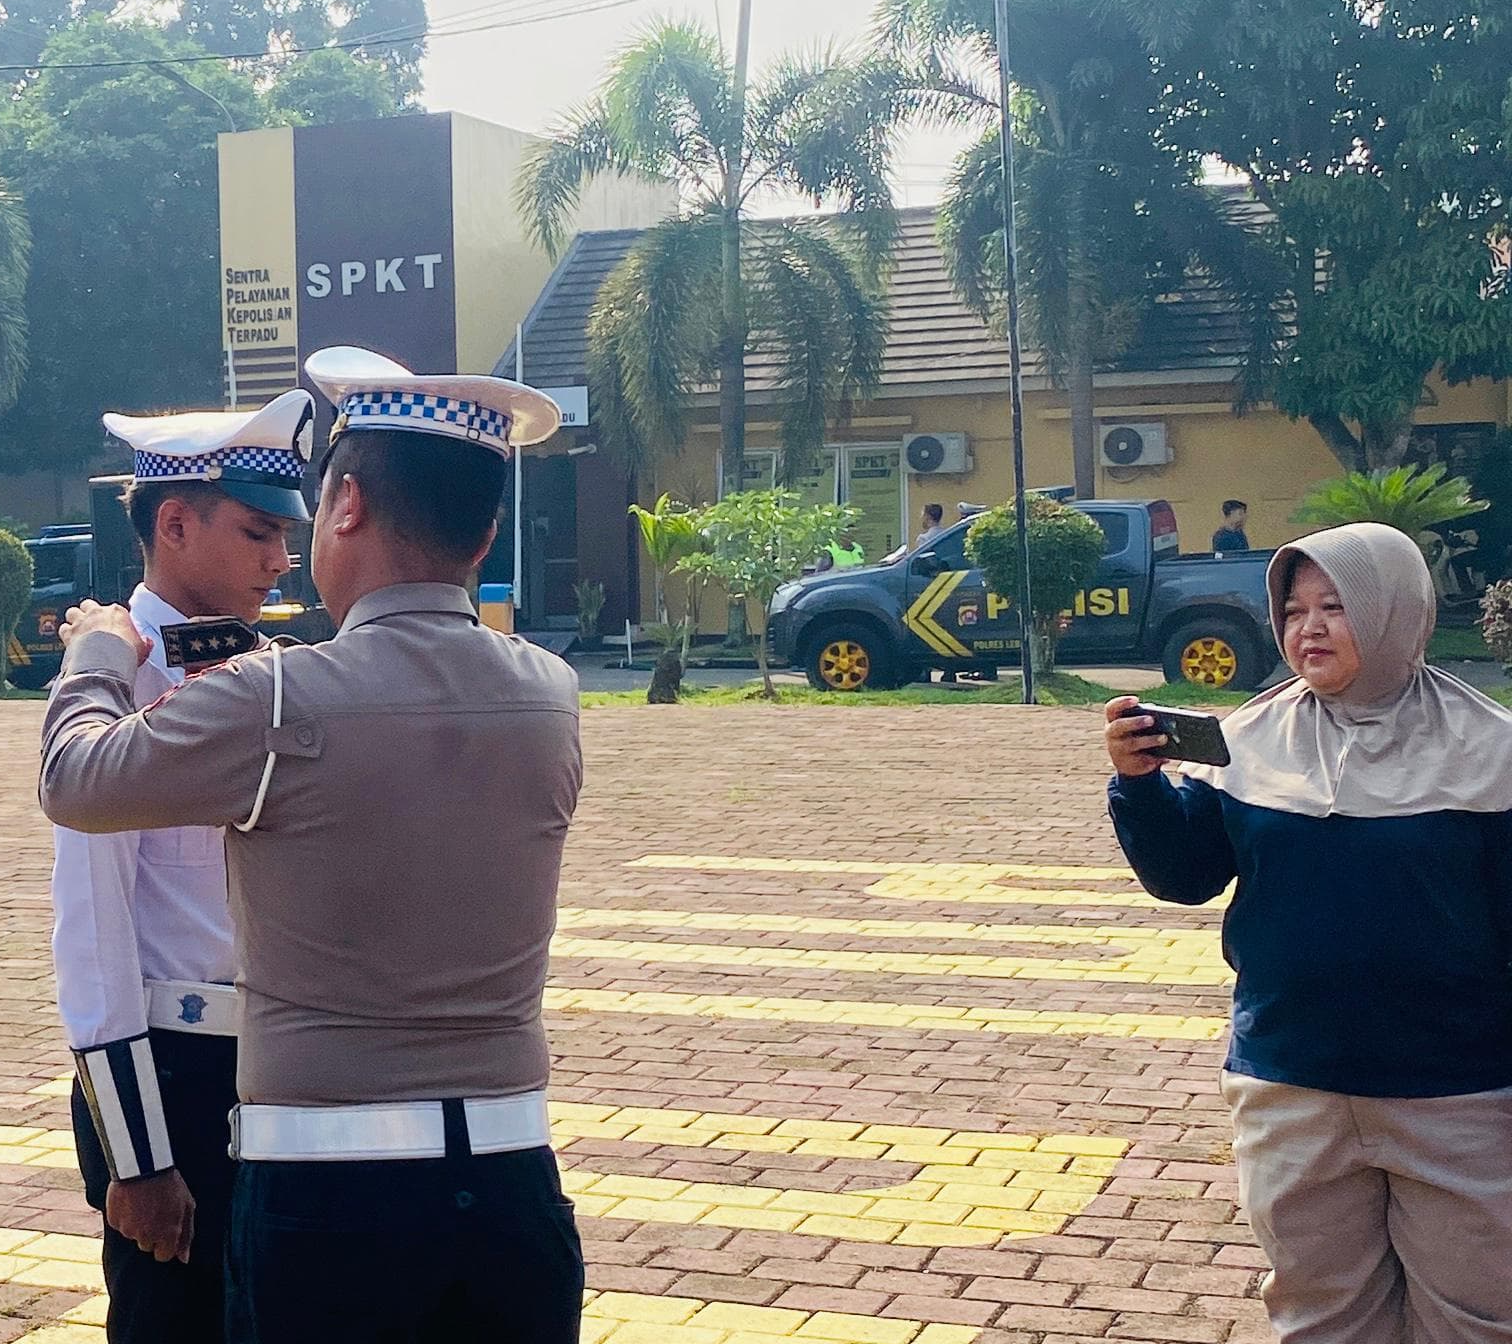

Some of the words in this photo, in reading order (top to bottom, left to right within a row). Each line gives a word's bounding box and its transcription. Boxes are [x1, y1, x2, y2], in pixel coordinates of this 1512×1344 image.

[226, 267, 270, 284] SENTRA
[306, 254, 442, 298] SPKT
[226, 287, 290, 304] PELAYANAN
[227, 307, 292, 324] KEPOLISAN
[227, 327, 278, 344] TERPADU
[987, 587, 1129, 620] PISI
